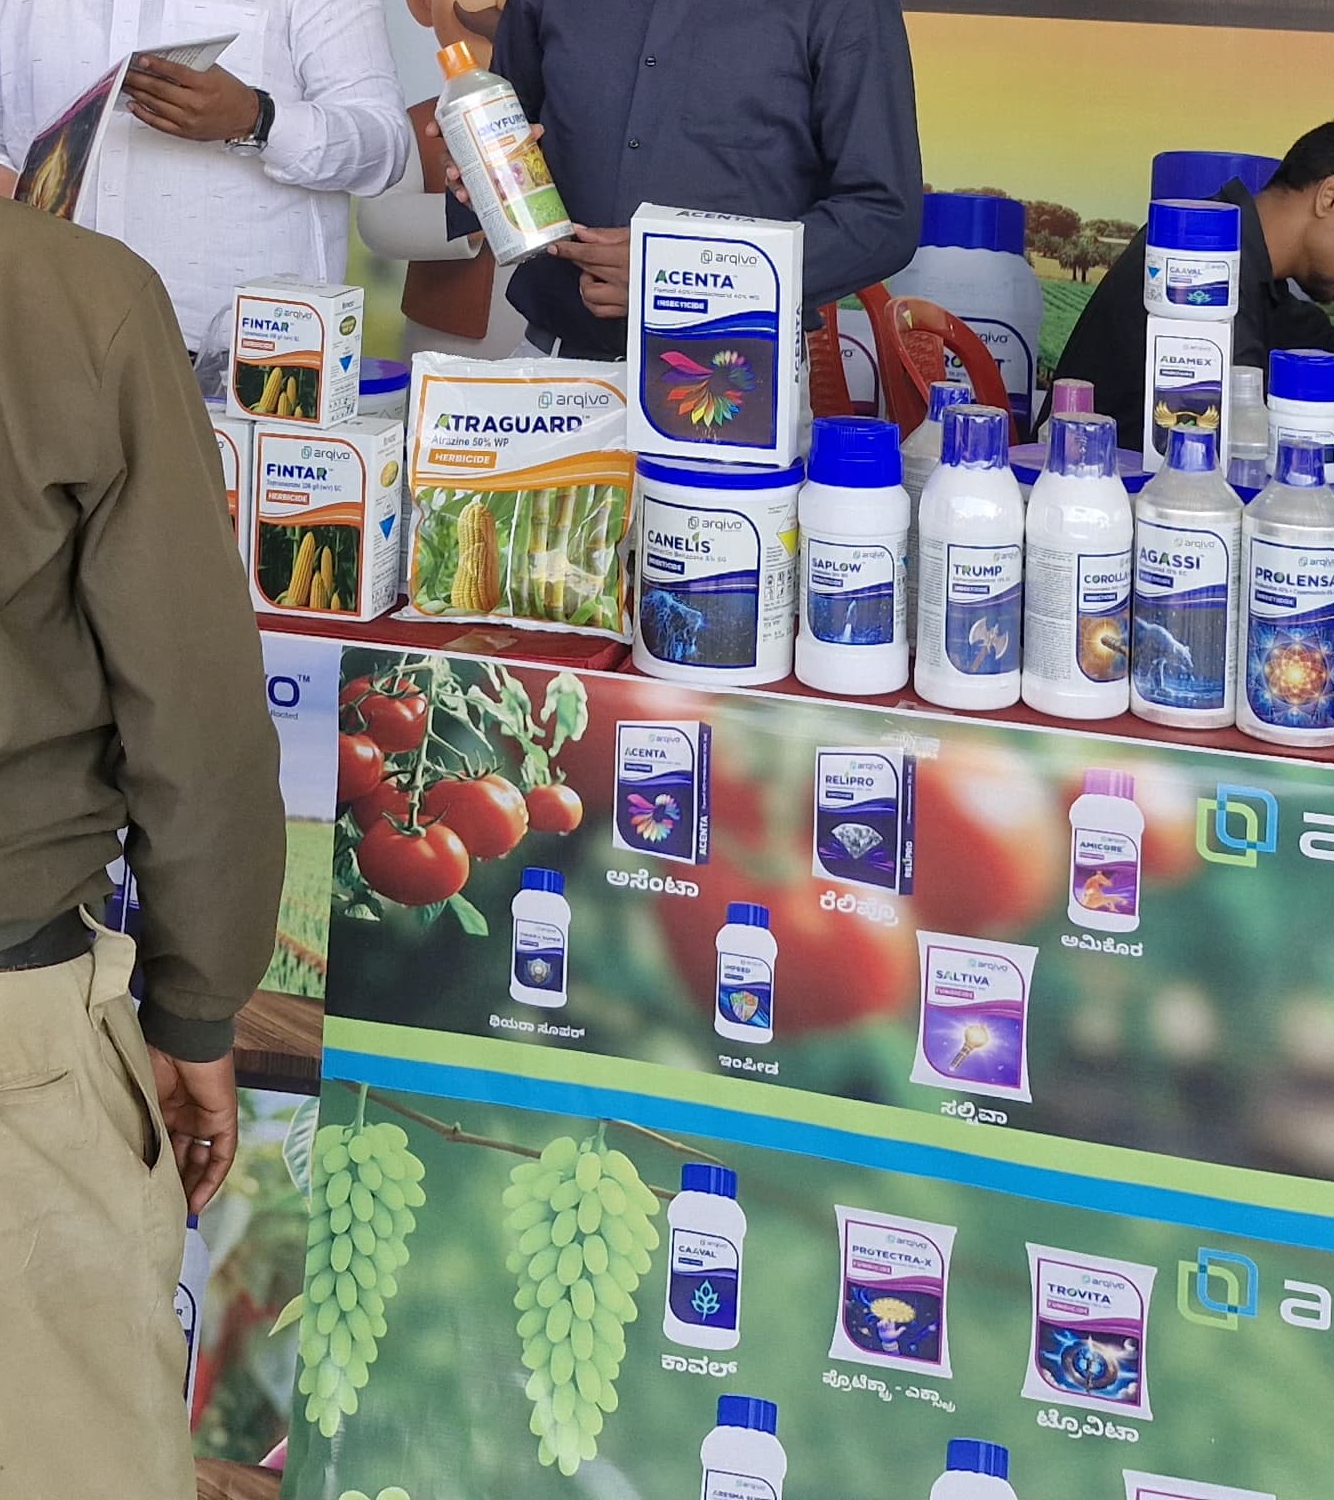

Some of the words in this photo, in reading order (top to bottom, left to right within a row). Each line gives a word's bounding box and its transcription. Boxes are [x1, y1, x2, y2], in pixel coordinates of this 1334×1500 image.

[676, 210, 756, 223] ACENTA
[715, 253, 758, 266] arqivo
[654, 268, 734, 290] ACENTA
[242, 317, 289, 333] FINTAR
[793, 304, 803, 384] ACENTA
[556, 392, 609, 409] arqivo
[434, 413, 583, 434] ATRAGUARD
[471, 437, 492, 448] 50%
[494, 437, 510, 448] WP
[314, 449, 351, 461] arqivo
[434, 453, 491, 465] HERBICIDE
[267, 463, 328, 481] FINTAR
[702, 519, 743, 532] arqivo
[647, 529, 712, 554] CANELIS
[811, 557, 862, 572] SAPLOW
[1140, 546, 1200, 570] AGASSI
[953, 563, 1002, 578] TRUMP
[624, 747, 667, 759] ACENTA
[825, 772, 874, 787] RELIPRO
[698, 815, 709, 856] ACENTA
[1080, 841, 1123, 853] AMICORE
[936, 969, 990, 987] SALTIVA
[678, 1244, 717, 1259] CAAVAL
[852, 1244, 932, 1268] PROTECTRA-X
[1047, 1282, 1111, 1305] TROVITA
